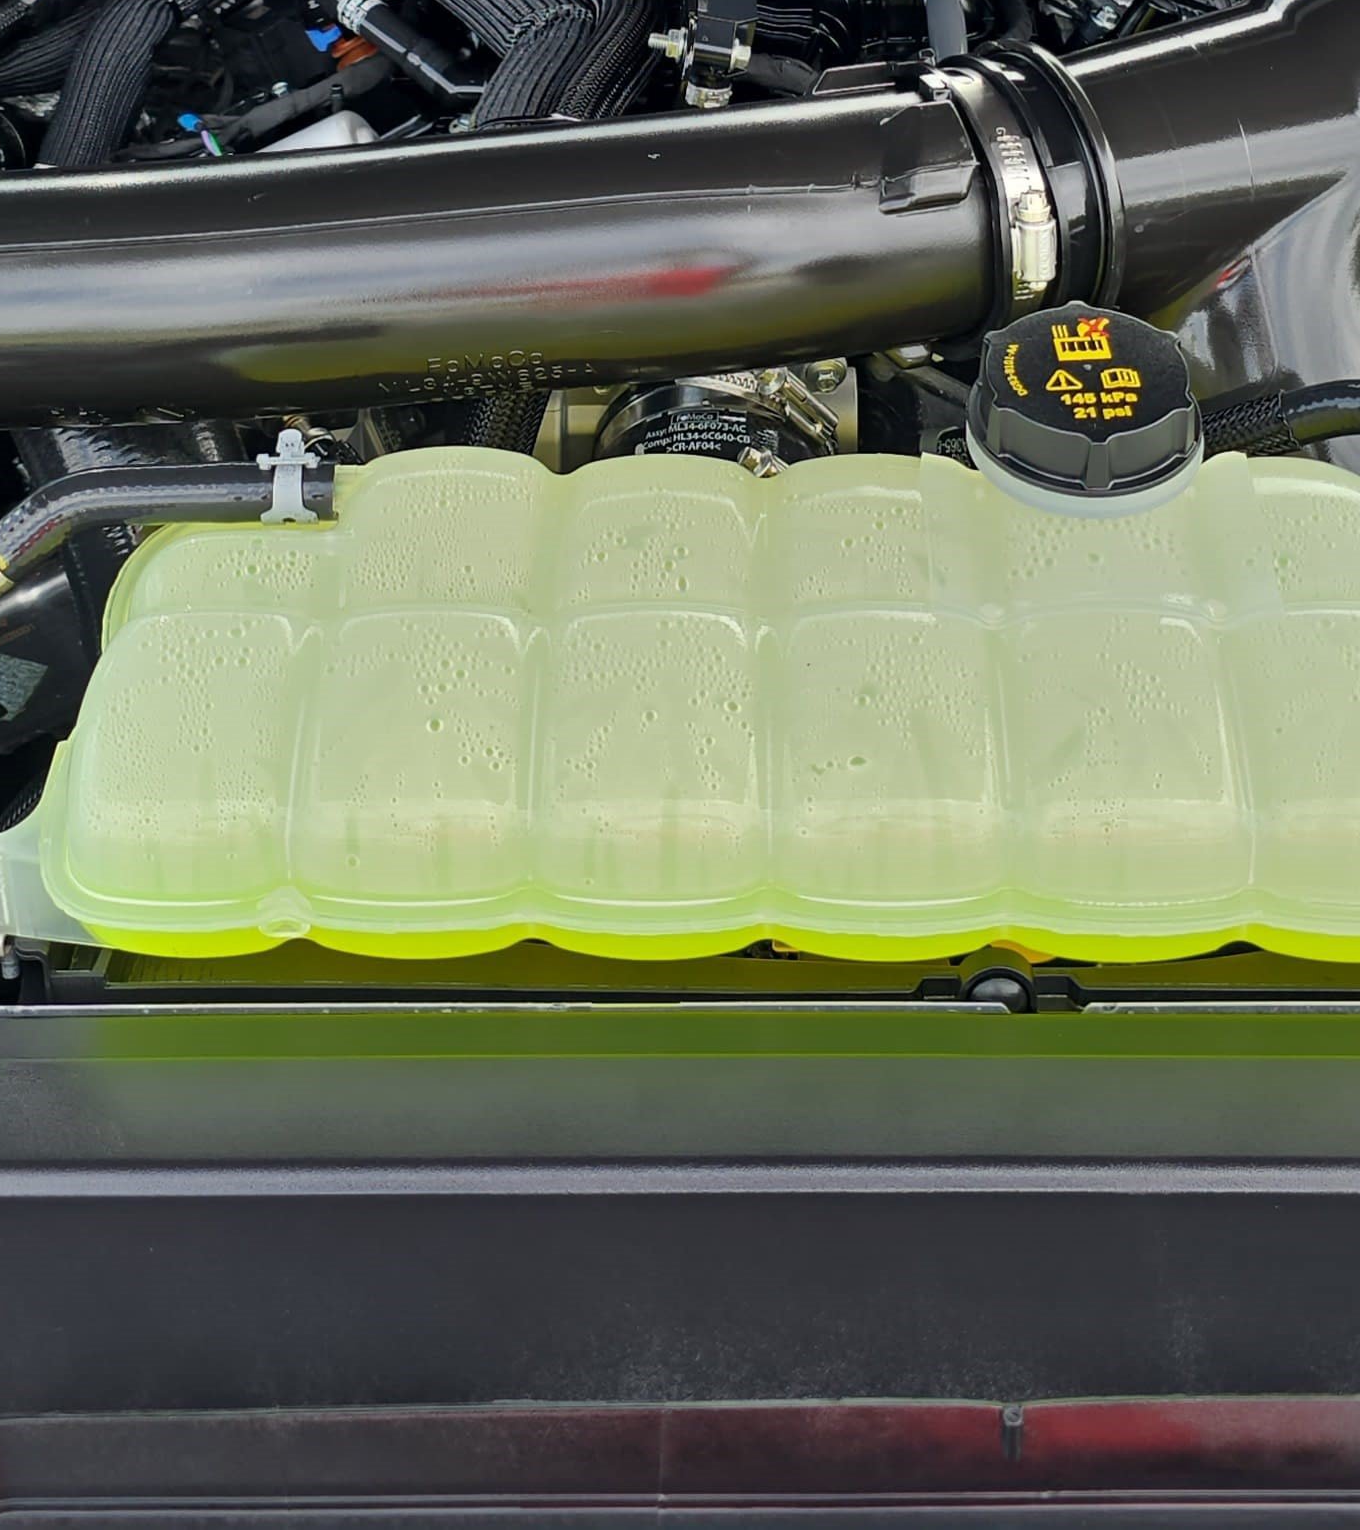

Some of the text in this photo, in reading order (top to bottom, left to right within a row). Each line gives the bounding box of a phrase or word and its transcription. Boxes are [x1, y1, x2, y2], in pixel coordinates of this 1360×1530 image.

[427, 350, 543, 374] FoMoCo
[1060, 391, 1138, 406] 145 kPa
[1073, 406, 1133, 420] 21 psi
